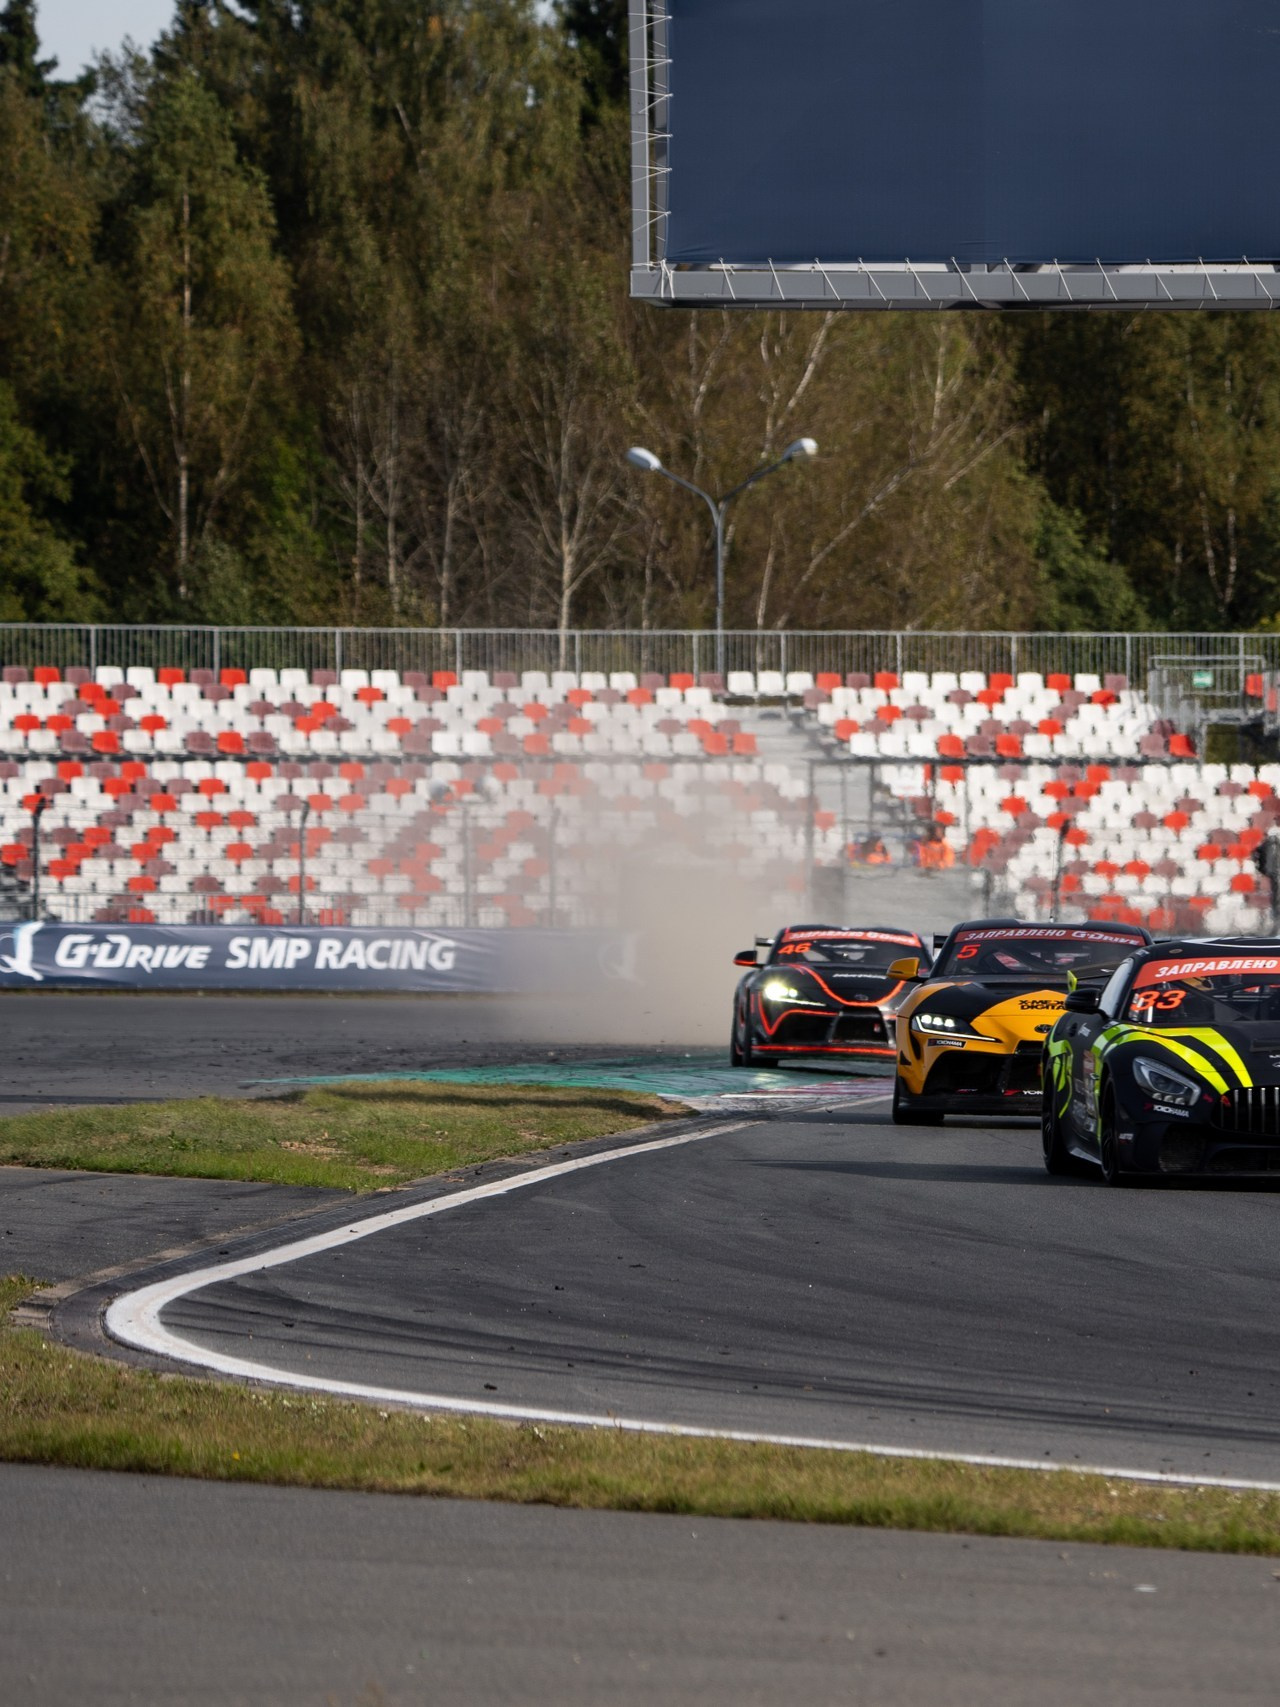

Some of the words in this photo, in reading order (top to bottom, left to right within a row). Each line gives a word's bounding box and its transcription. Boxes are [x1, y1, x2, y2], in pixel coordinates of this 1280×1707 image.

[964, 930, 1066, 941] ЗАПРАВЛЕНО
[225, 936, 311, 969] SMP
[315, 938, 456, 971] RACING
[778, 942, 812, 955] 46
[957, 944, 981, 959] 5
[1155, 960, 1278, 977] ЗАПРАВЛЕНО
